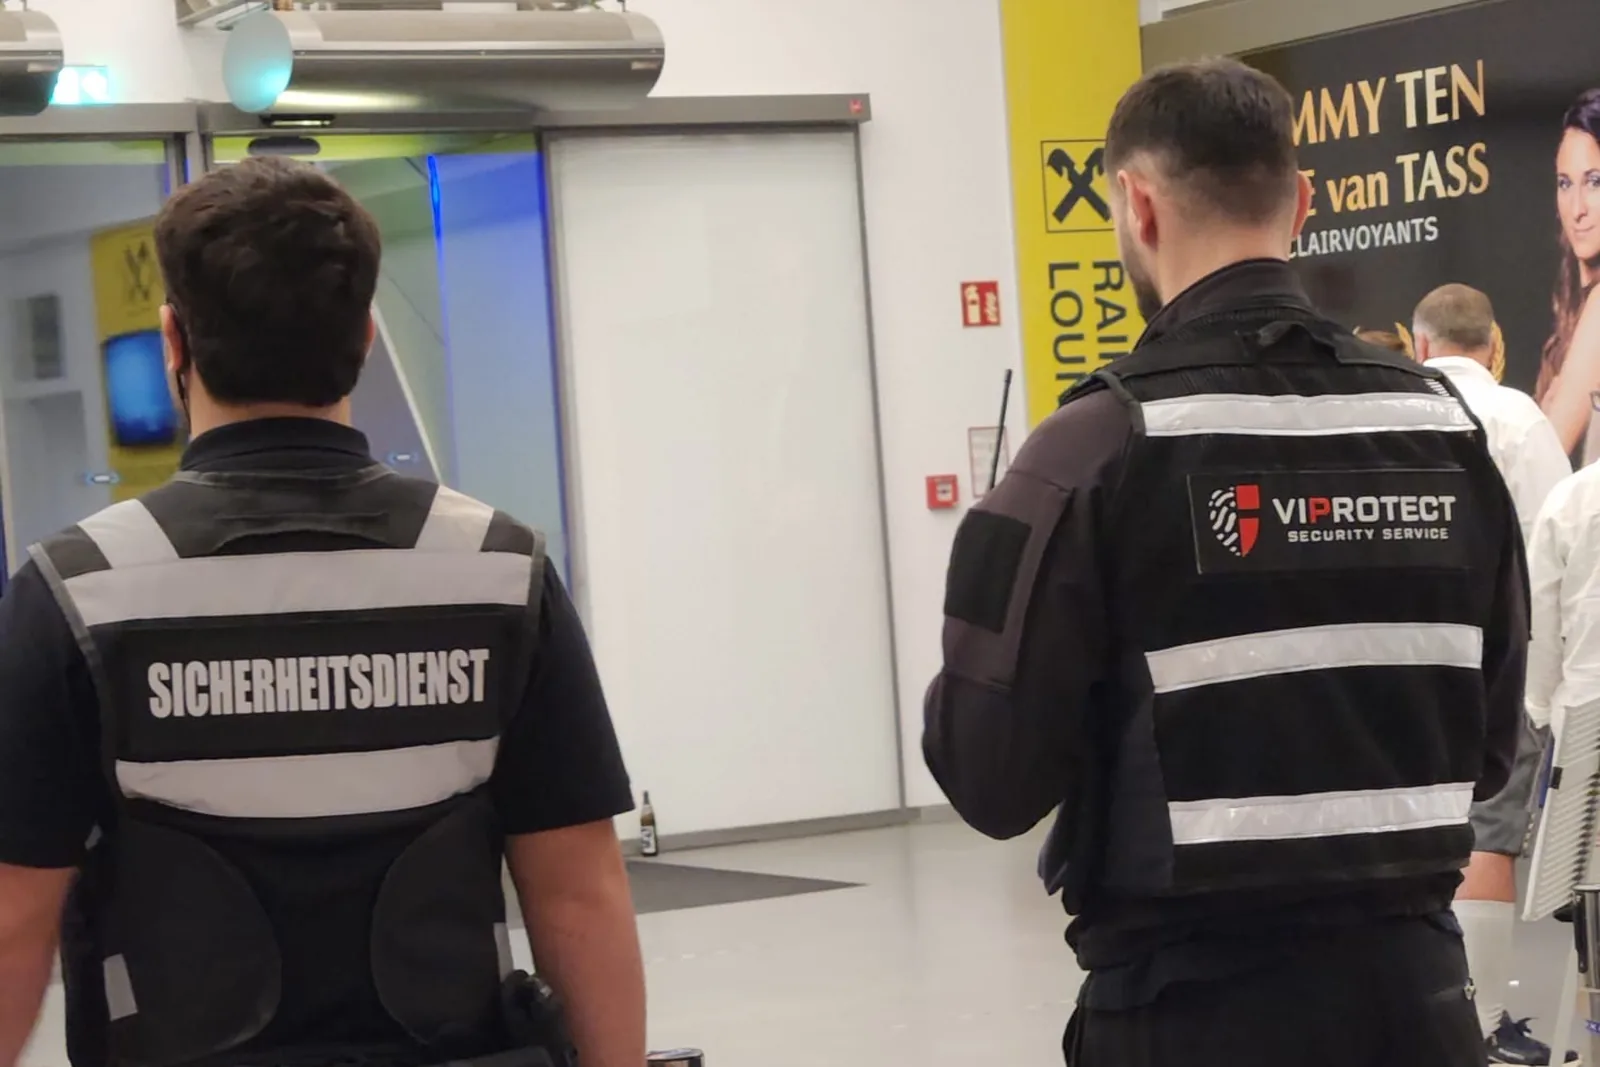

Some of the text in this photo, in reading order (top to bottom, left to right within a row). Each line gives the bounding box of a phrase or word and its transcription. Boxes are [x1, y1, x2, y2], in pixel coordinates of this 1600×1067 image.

[1395, 59, 1486, 129] TEN
[1326, 170, 1389, 214] van
[1395, 142, 1490, 203] TASS
[1289, 216, 1439, 259] LAIRVOYANTS
[1272, 495, 1456, 525] VIPROTECT
[1287, 527, 1449, 543] SECURITY SERVICE
[147, 648, 490, 719] SICHERHEITSDIENST
